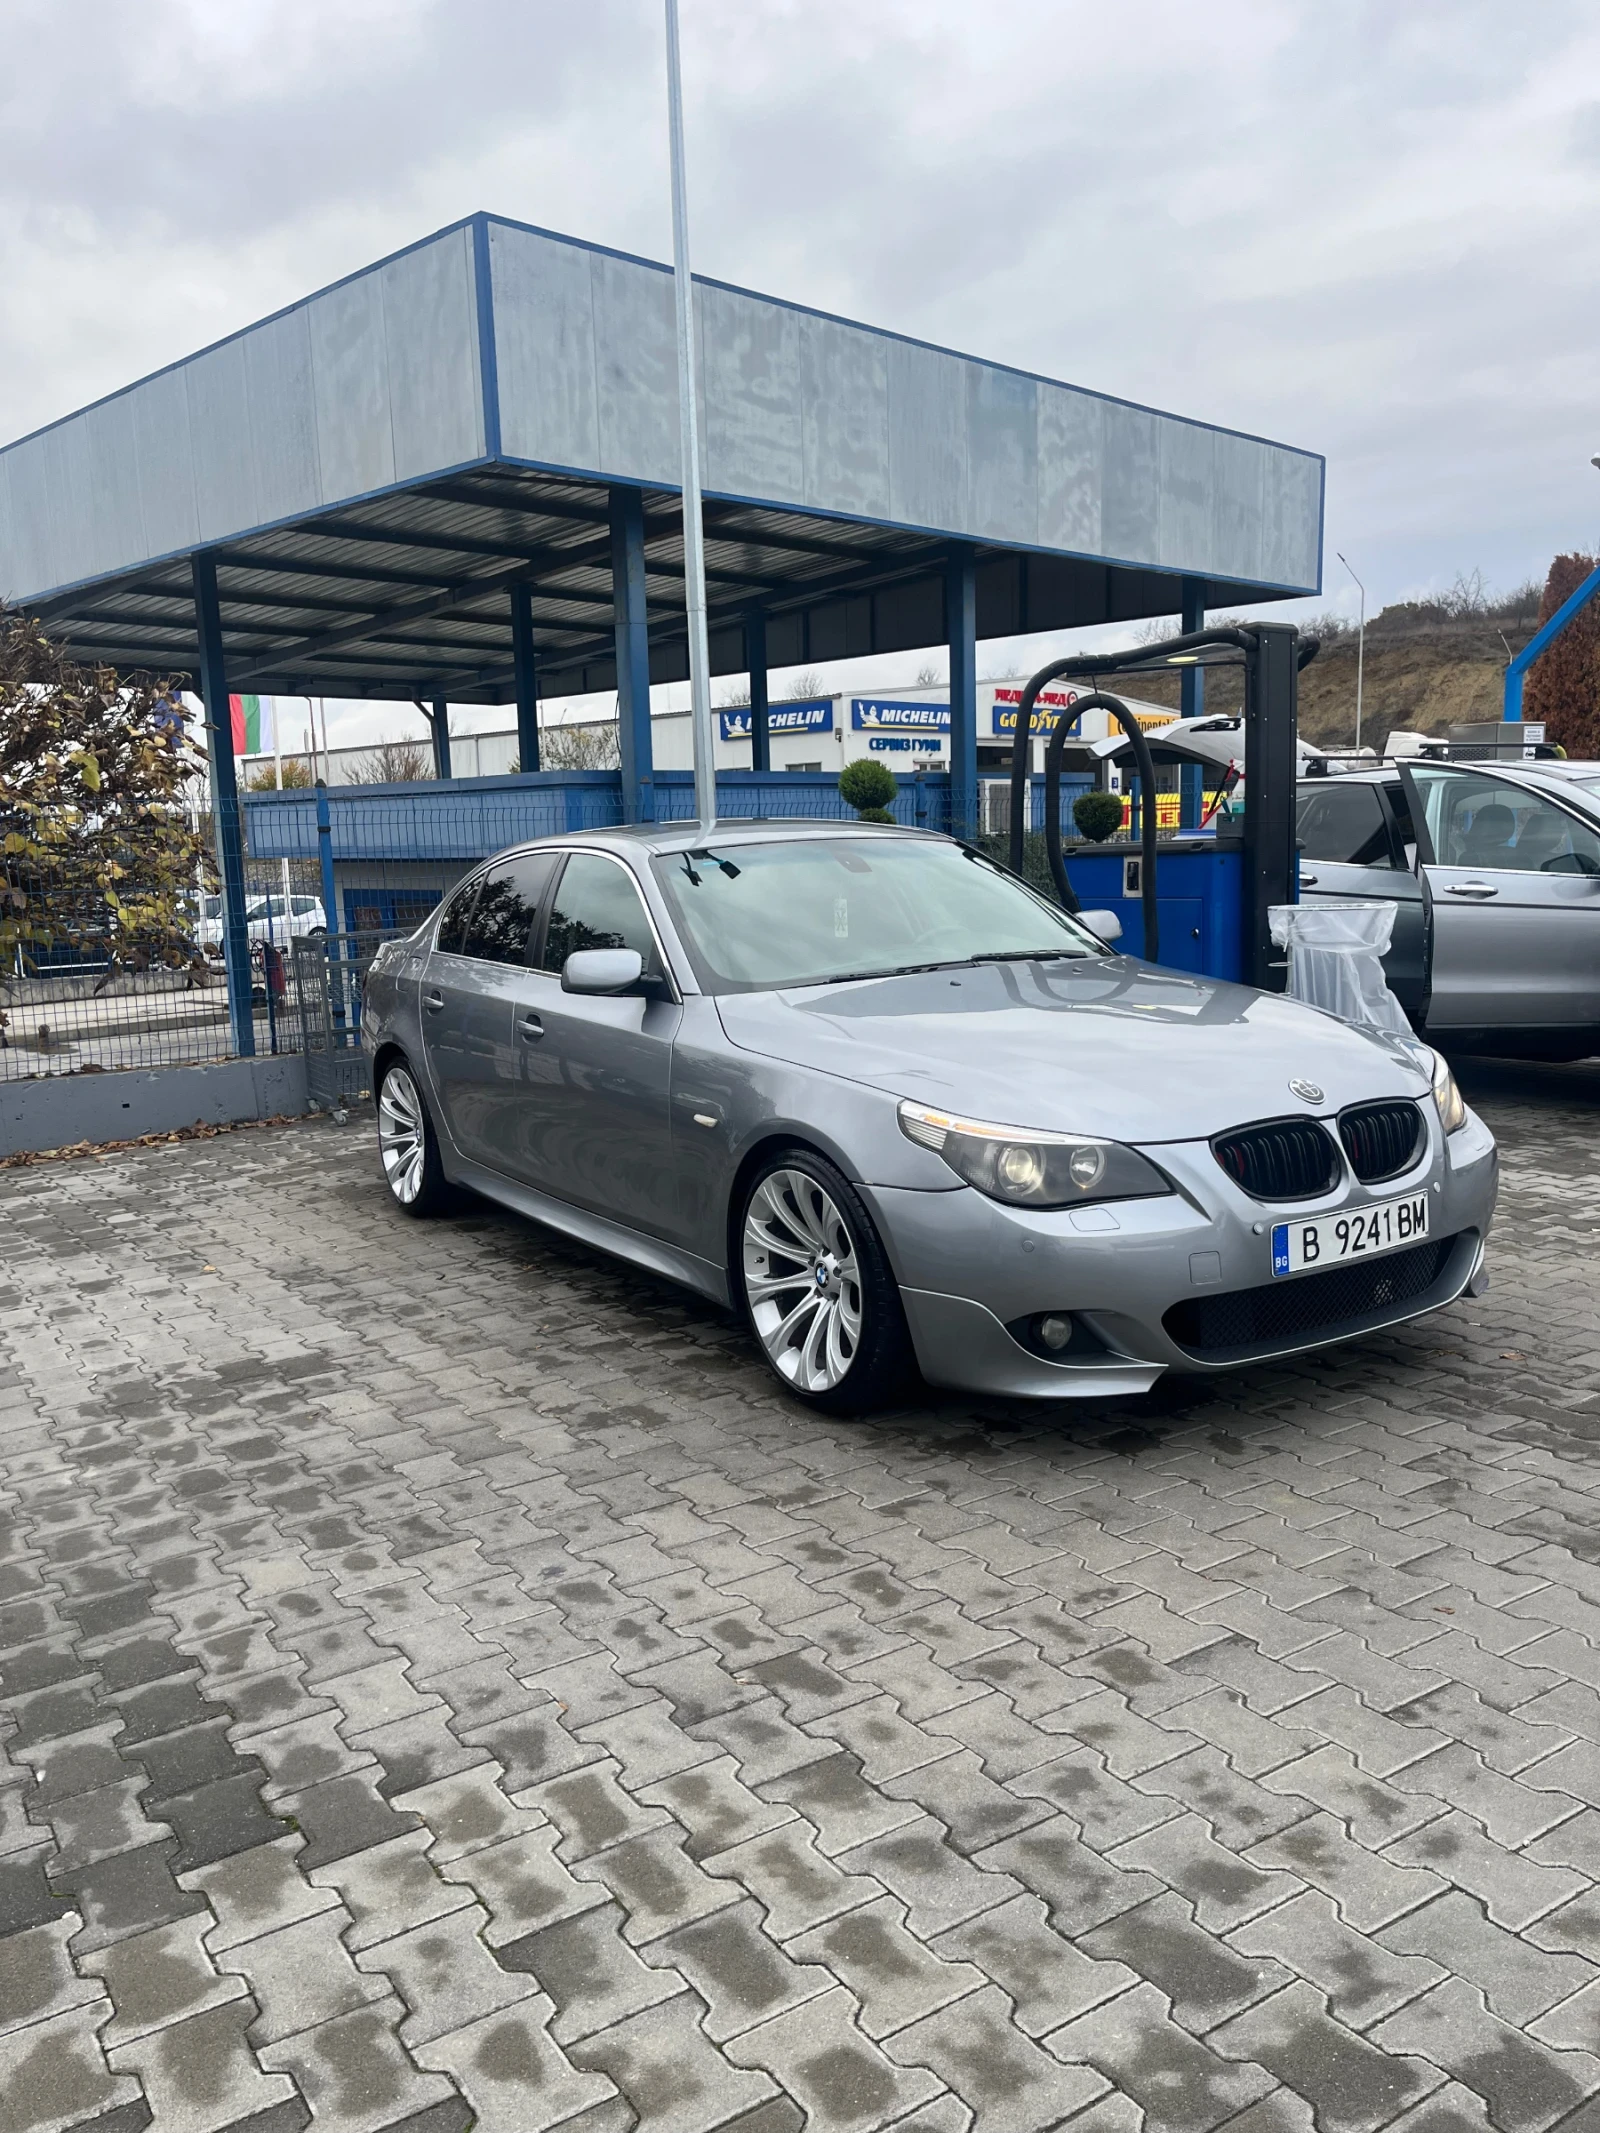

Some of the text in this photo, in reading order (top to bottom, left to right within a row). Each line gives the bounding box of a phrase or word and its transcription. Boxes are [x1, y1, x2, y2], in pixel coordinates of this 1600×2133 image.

[746, 710, 825, 730] CHELIN
[881, 709, 951, 724] MICHELIN
[869, 737, 942, 752] СЕРВИЗ ГУМИ
[1302, 1198, 1426, 1263] B 9241 BM
[1275, 1256, 1288, 1268] BG
